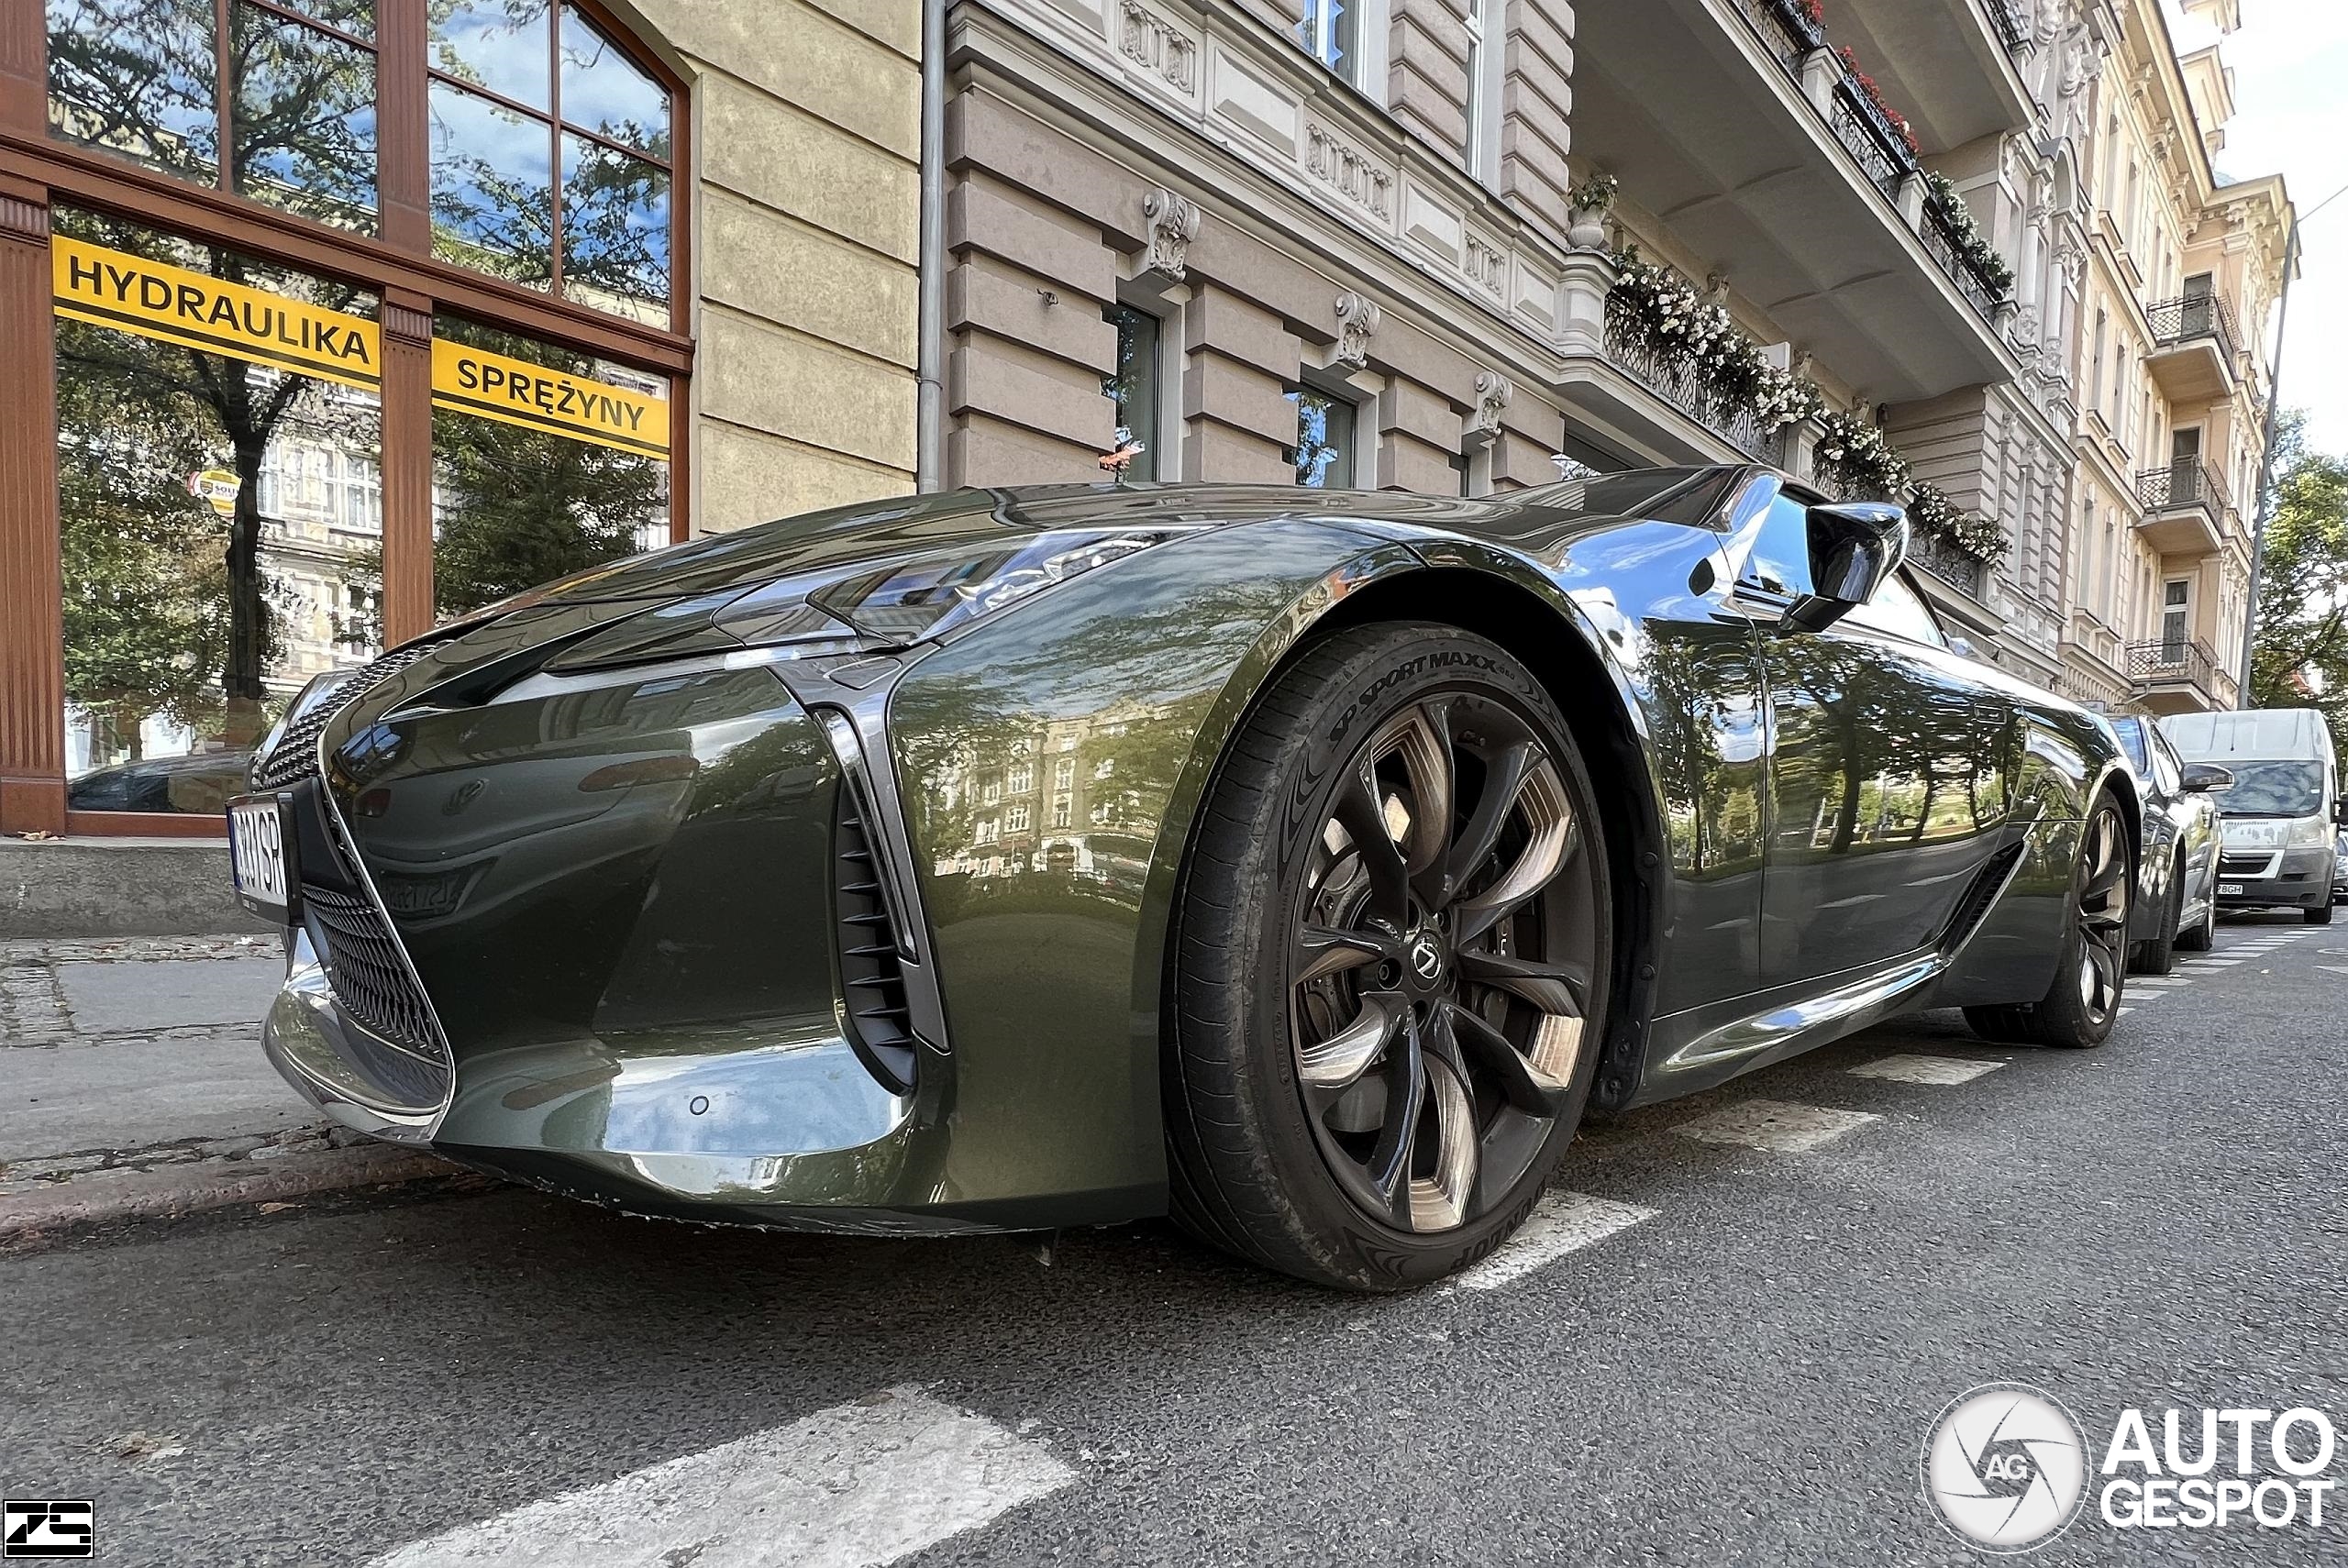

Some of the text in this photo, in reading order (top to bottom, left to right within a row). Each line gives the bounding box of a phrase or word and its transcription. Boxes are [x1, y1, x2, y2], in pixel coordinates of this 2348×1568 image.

[70, 255, 371, 364] HYDRAULIKA
[458, 359, 645, 431] SPRĘŻYNY
[1358, 656, 1427, 714] SPORT
[1429, 651, 1499, 674] MAXX
